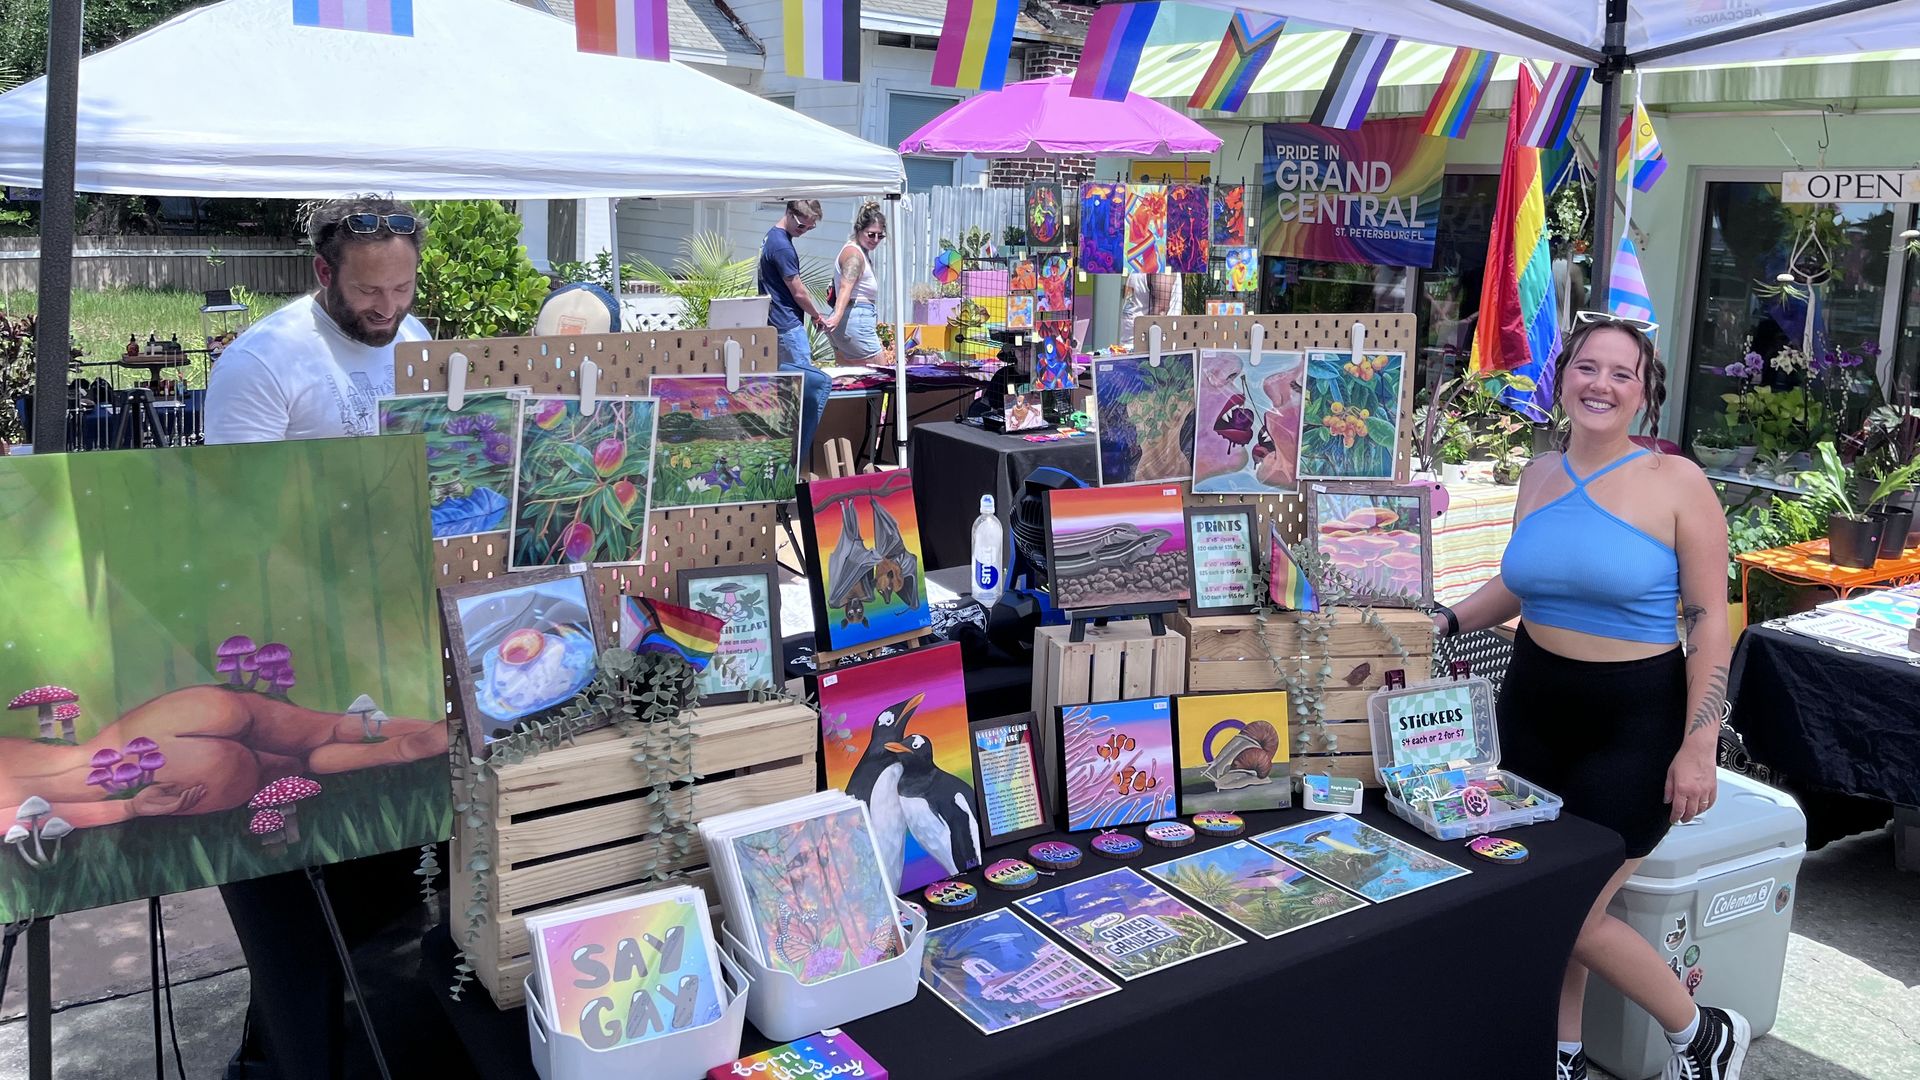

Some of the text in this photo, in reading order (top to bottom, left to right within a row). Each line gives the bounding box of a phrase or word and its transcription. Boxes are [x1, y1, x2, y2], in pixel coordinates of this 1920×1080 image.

[1276, 145, 1340, 160] PRIDE IN
[1275, 161, 1392, 193] GRAND
[1807, 173, 1905, 199] OPEN
[1278, 192, 1425, 228] CENTRAL
[1335, 227, 1347, 237] ST.
[1402, 738, 1411, 746] $4
[1412, 736, 1428, 745] each
[1438, 732, 1443, 740] 2
[1444, 731, 1455, 740] for
[1456, 729, 1465, 738] $7
[991, 863, 1030, 879] PRIDE
[932, 882, 963, 897] SAY
[941, 888, 974, 903] GAY
[1714, 892, 1758, 915] Coleman
[1102, 917, 1156, 942] SUNKEN
[1106, 926, 1171, 955] GARDENS
[571, 926, 686, 989] SAY
[579, 975, 699, 1049] GAY
[731, 1050, 800, 1076] born
[772, 1059, 825, 1080] this
[813, 1059, 865, 1080] way
